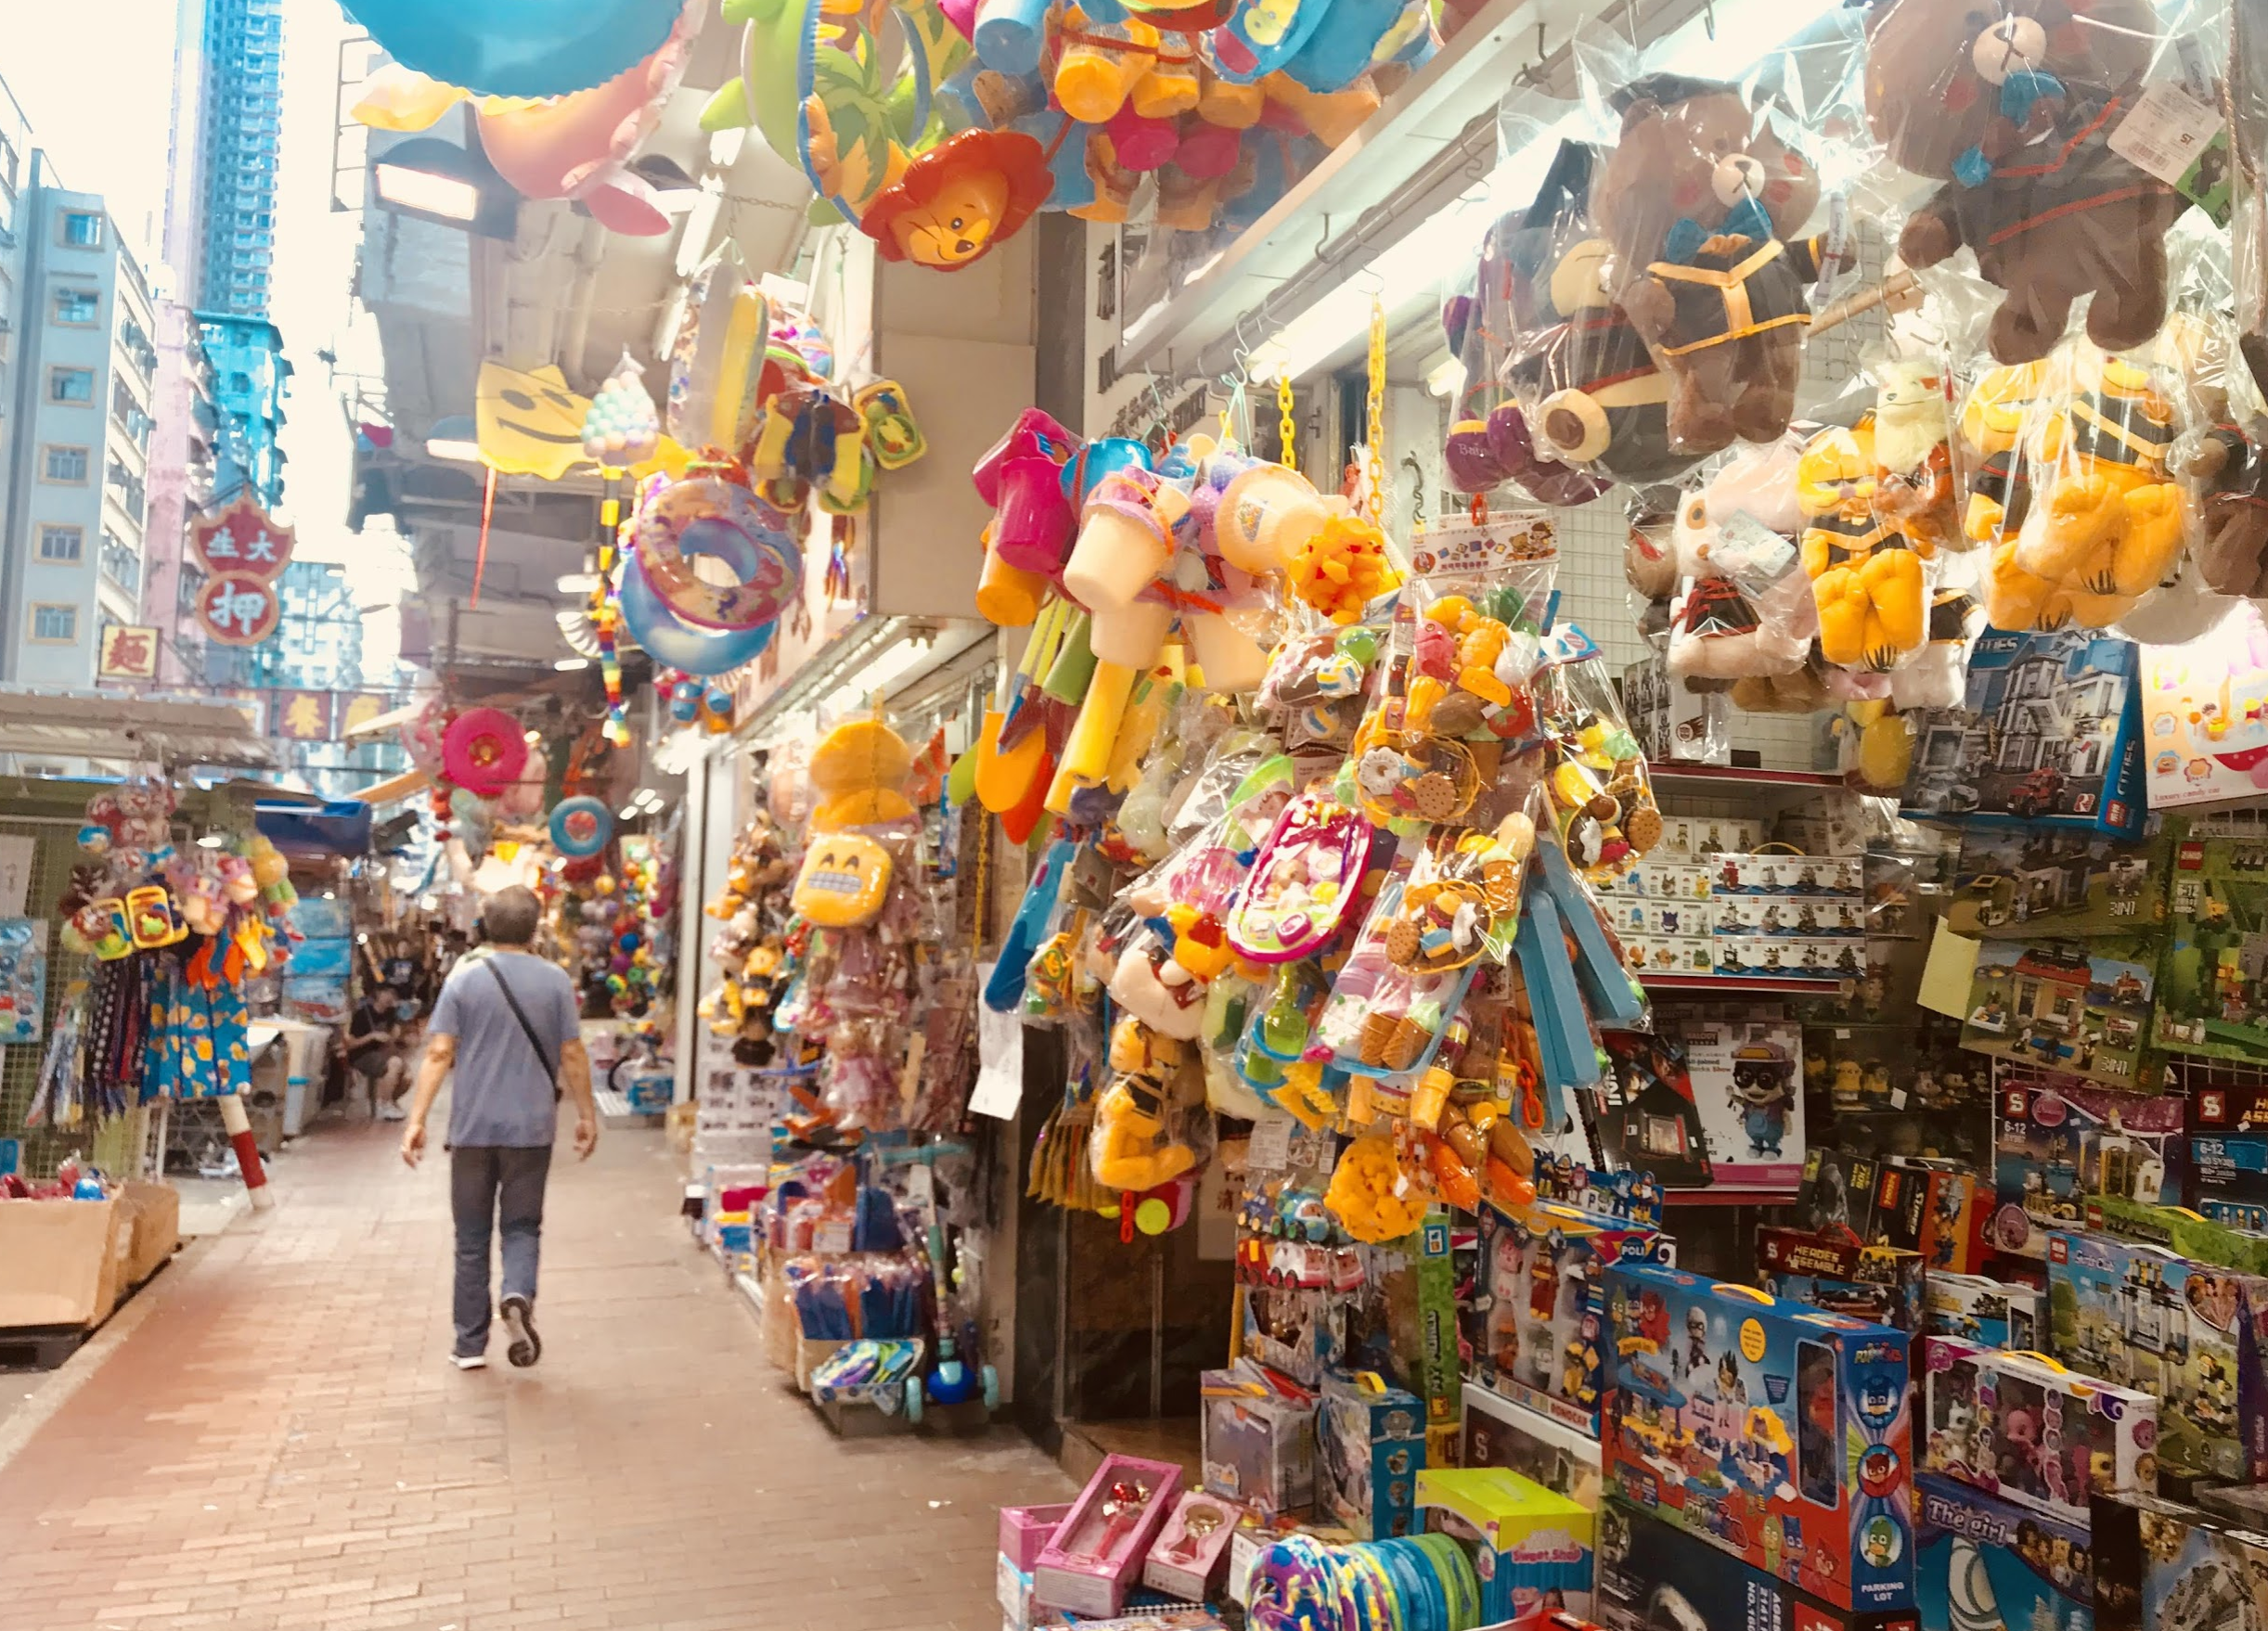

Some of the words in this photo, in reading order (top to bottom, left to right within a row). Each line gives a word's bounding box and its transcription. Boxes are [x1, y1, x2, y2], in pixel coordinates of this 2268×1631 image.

[208, 581, 267, 636] 押
[2008, 1095, 2024, 1111] S
[2204, 1097, 2220, 1116] S
[1621, 1245, 1645, 1256] POLI
[1794, 1244, 1840, 1263] HEROES
[1927, 1496, 1965, 1528] The
[1970, 1515, 2007, 1547] girl
[1862, 1581, 1904, 1593] PARKING
[1874, 1592, 1893, 1602] LOT
